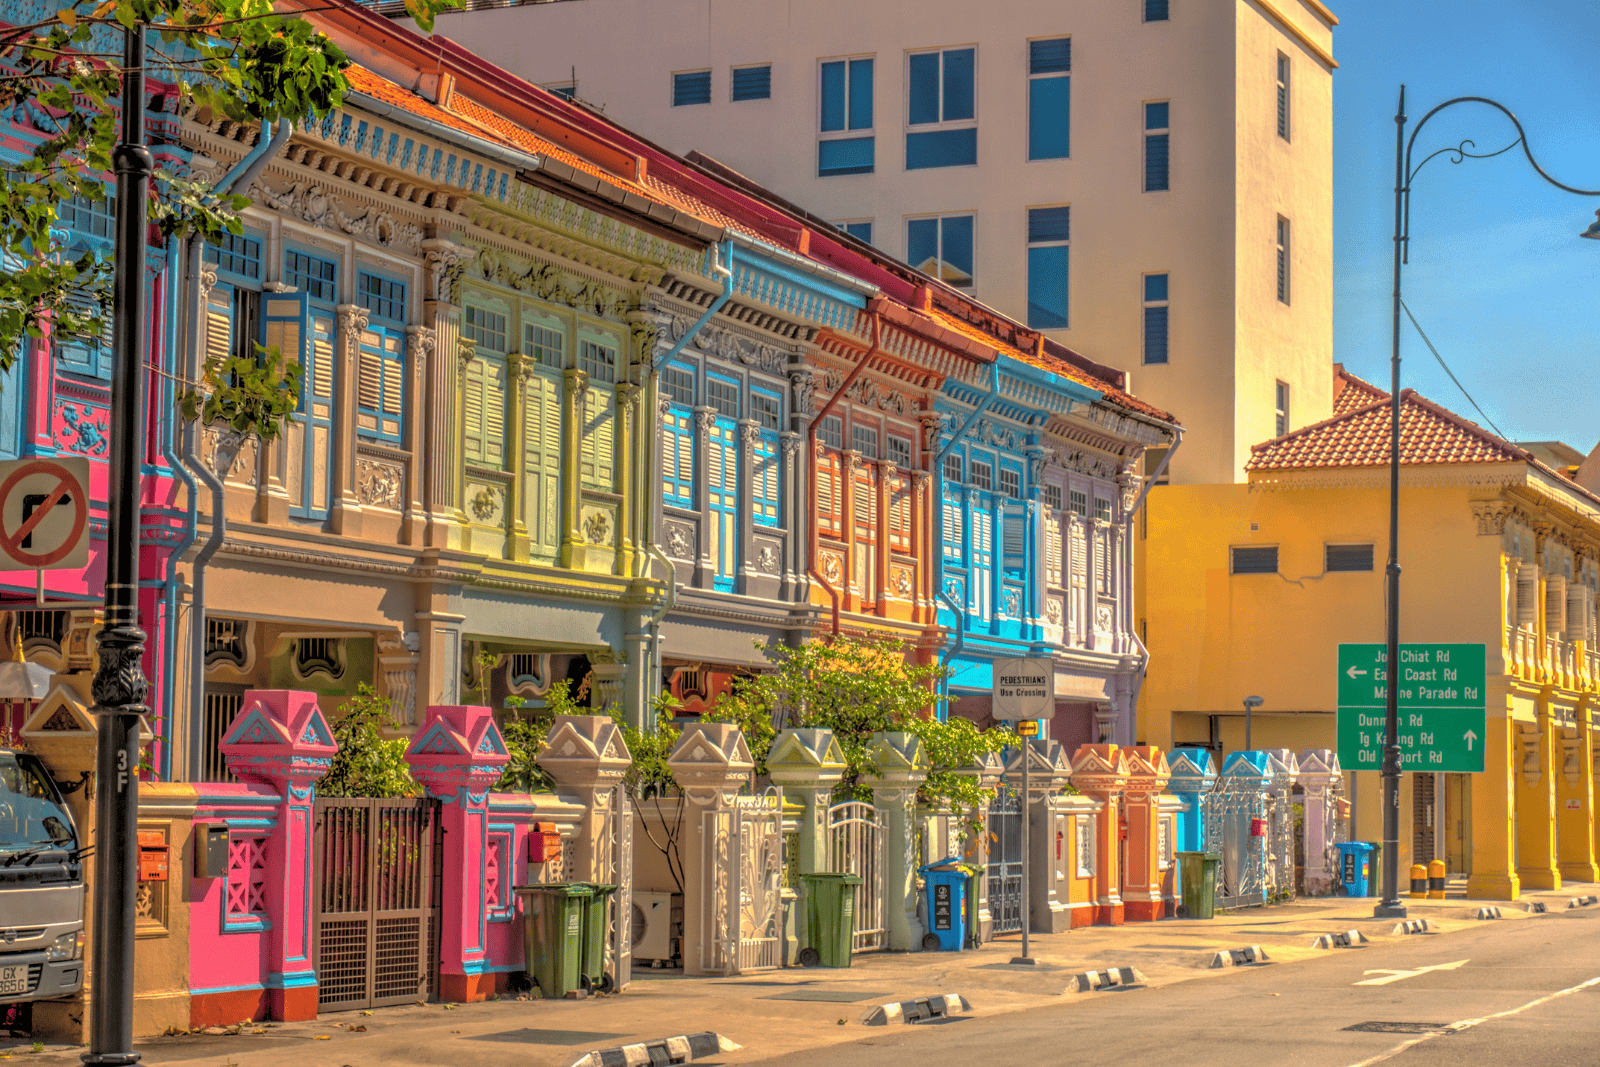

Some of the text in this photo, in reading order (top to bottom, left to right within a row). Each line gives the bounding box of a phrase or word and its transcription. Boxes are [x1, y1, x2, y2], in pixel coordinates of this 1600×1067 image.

[1375, 650, 1450, 663] Jo Chiat Rd
[1000, 676, 1046, 684] PEDESTRIANS
[1405, 668, 1437, 681] Coast
[1444, 668, 1457, 681] Rd
[1000, 688, 1046, 697] Use Crossing
[1419, 686, 1457, 699] Parade
[1464, 686, 1478, 699] Rd
[1358, 713, 1423, 727] Dunmn Rd
[1359, 731, 1370, 747] Tg
[1420, 732, 1434, 745] Rd
[1358, 749, 1376, 762] Old
[1429, 750, 1443, 764] Rd
[3, 967, 16, 980] GX
